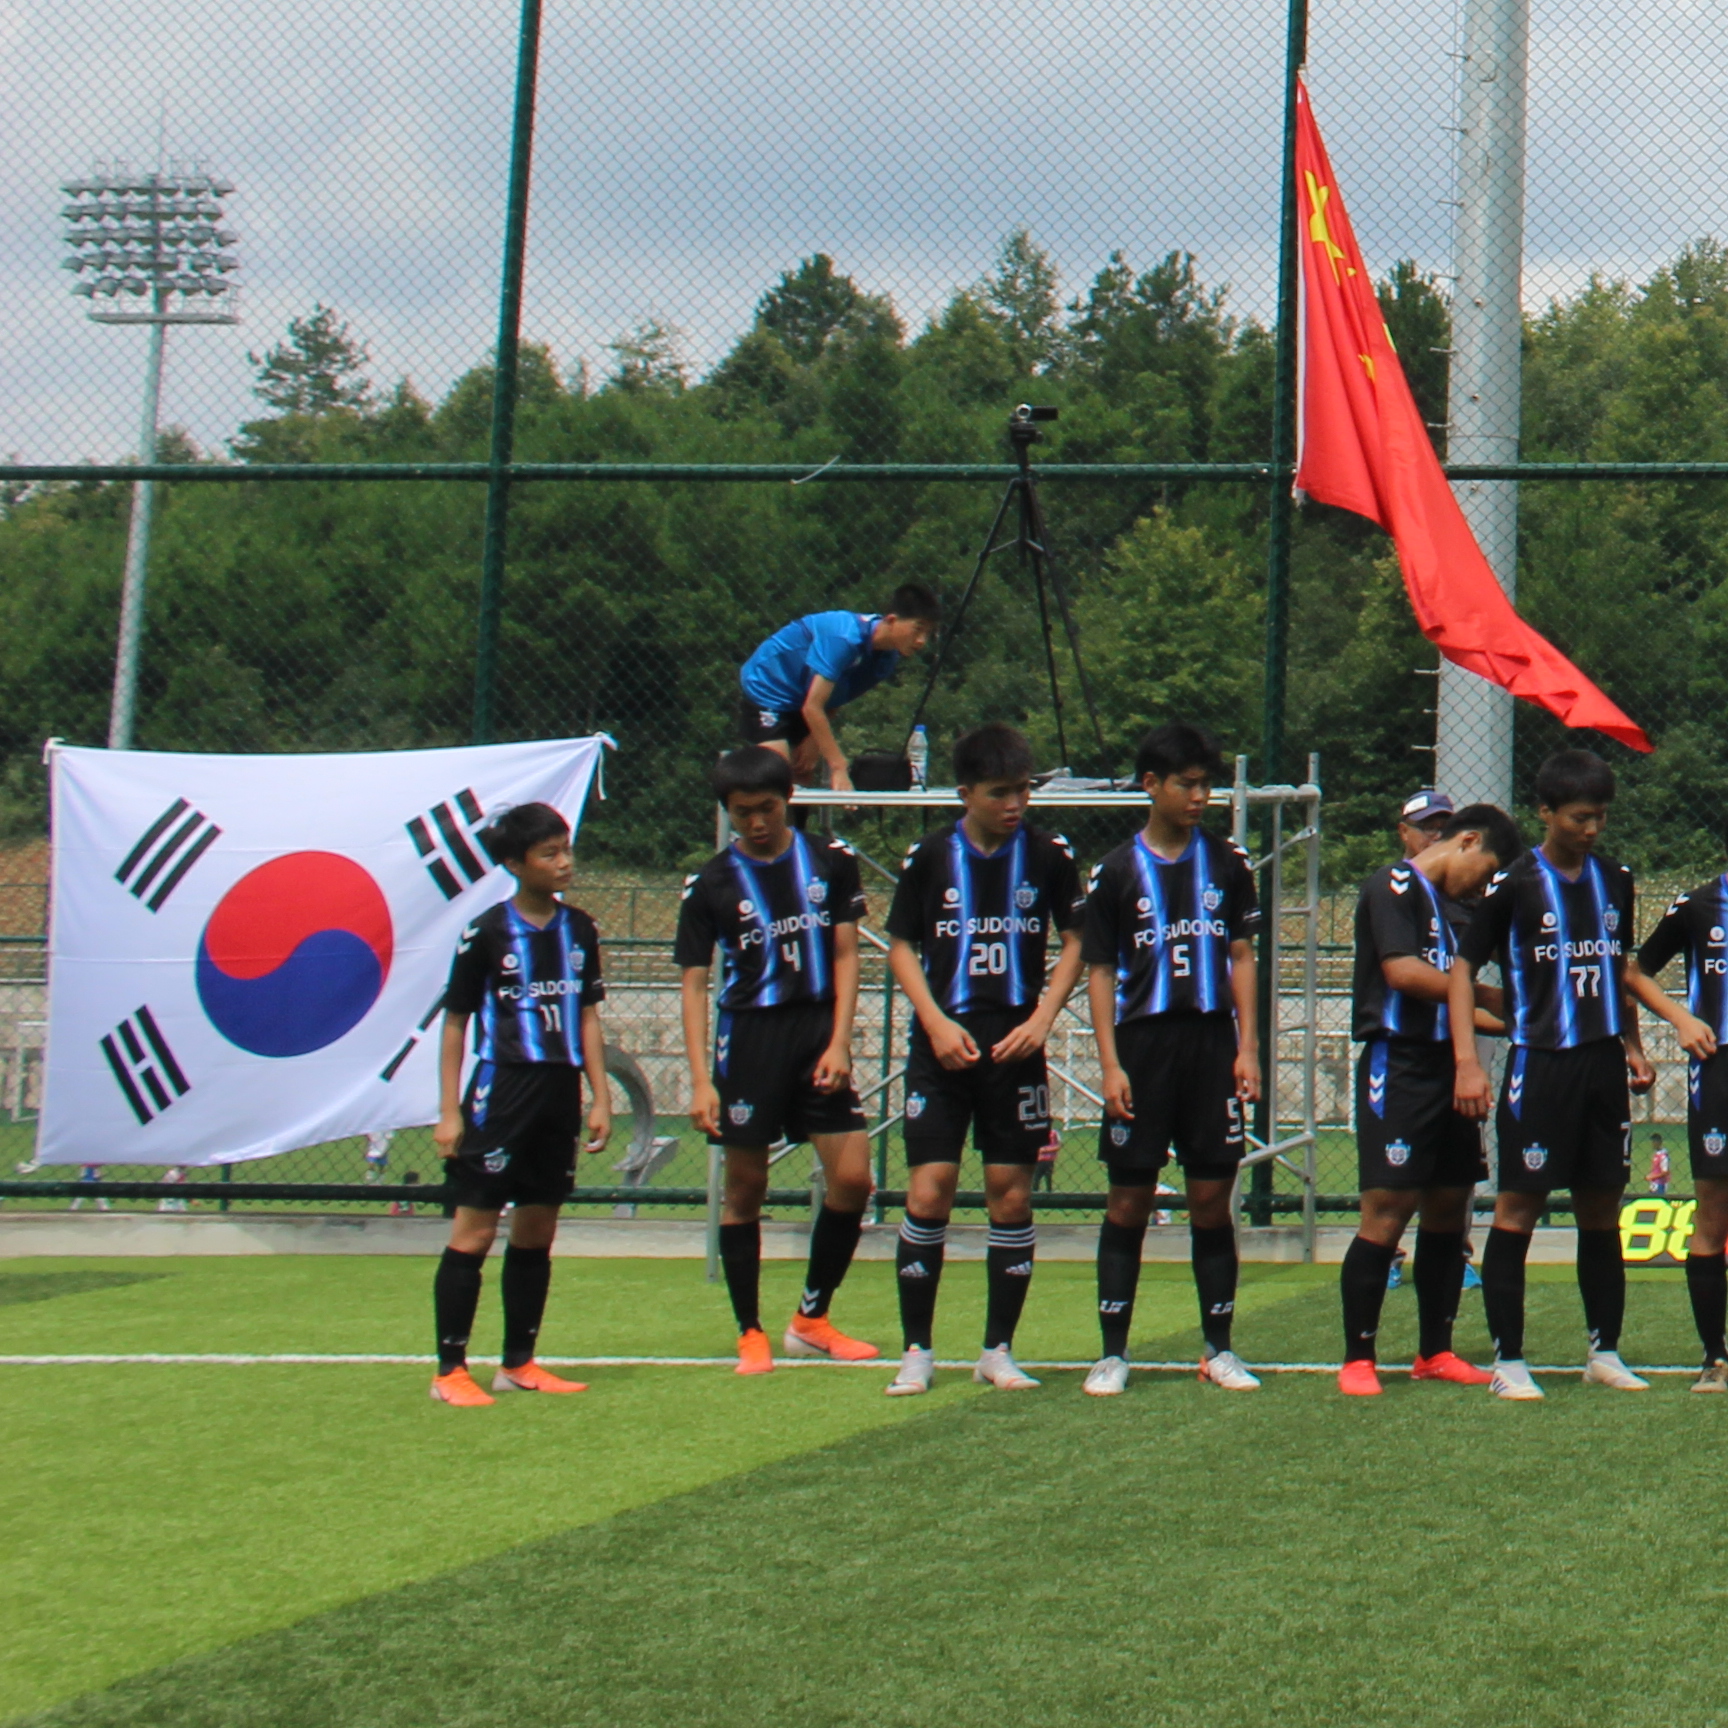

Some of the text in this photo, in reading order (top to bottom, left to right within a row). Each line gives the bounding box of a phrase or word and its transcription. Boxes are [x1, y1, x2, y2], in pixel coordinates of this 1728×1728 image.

[740, 928, 764, 950] FC
[769, 911, 831, 938] SUDONG
[936, 917, 1040, 938] FC SUDONG
[1134, 919, 1225, 949] FC SUDONG
[782, 940, 801, 972] 4
[969, 942, 1007, 976] 20
[1172, 944, 1190, 977] 5
[1534, 939, 1622, 962] FC SUDONG
[1569, 965, 1601, 998] 77
[1704, 959, 1728, 974] FC
[498, 986, 523, 1000] FC
[540, 1004, 562, 1032] 11
[1018, 1085, 1049, 1121] 20
